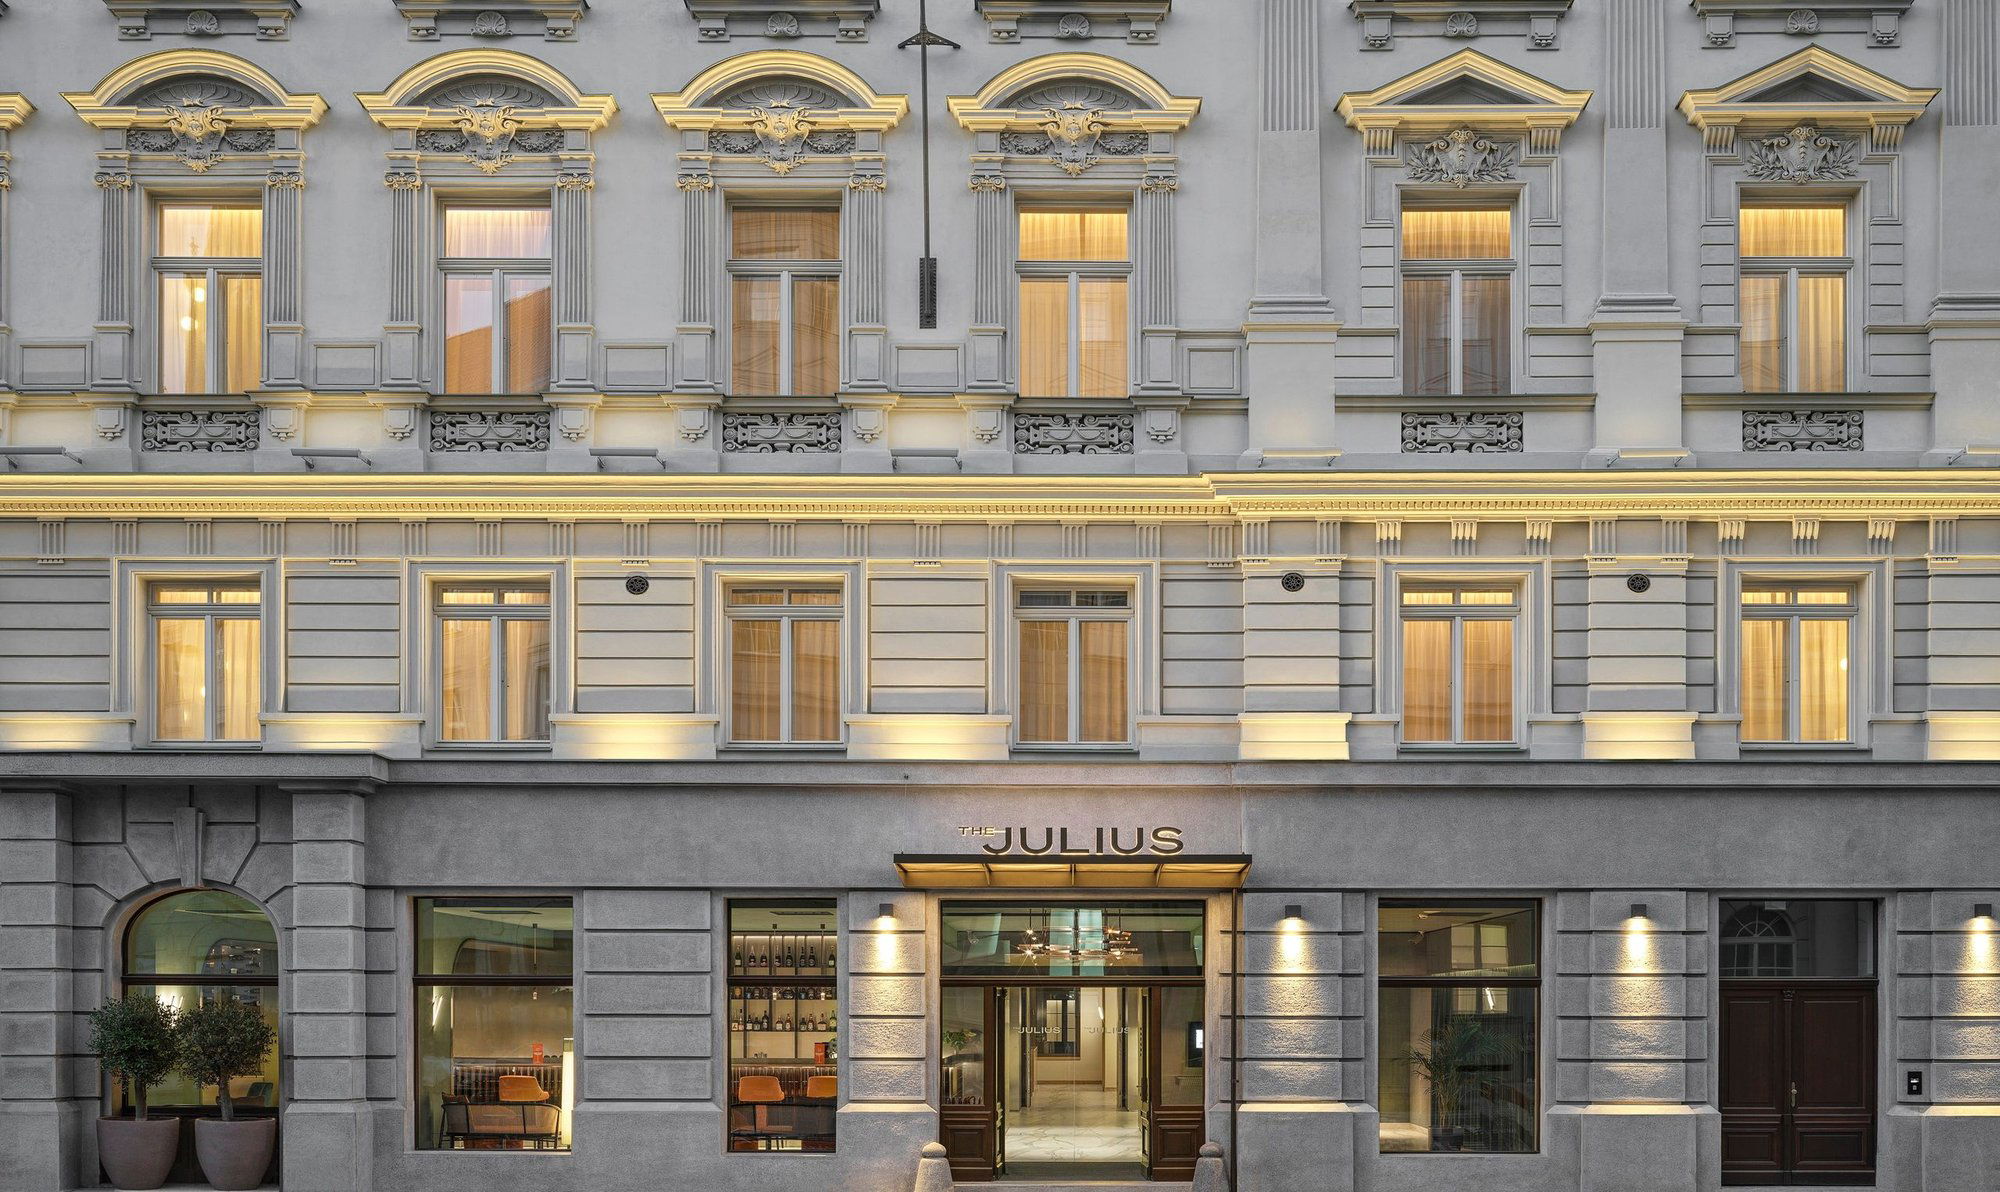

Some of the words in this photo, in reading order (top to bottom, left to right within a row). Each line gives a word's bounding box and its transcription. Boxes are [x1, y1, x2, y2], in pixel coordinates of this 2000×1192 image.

[958, 826, 995, 836] THE
[982, 826, 1184, 855] JULIUS
[1017, 1026, 1061, 1034] JULIUS
